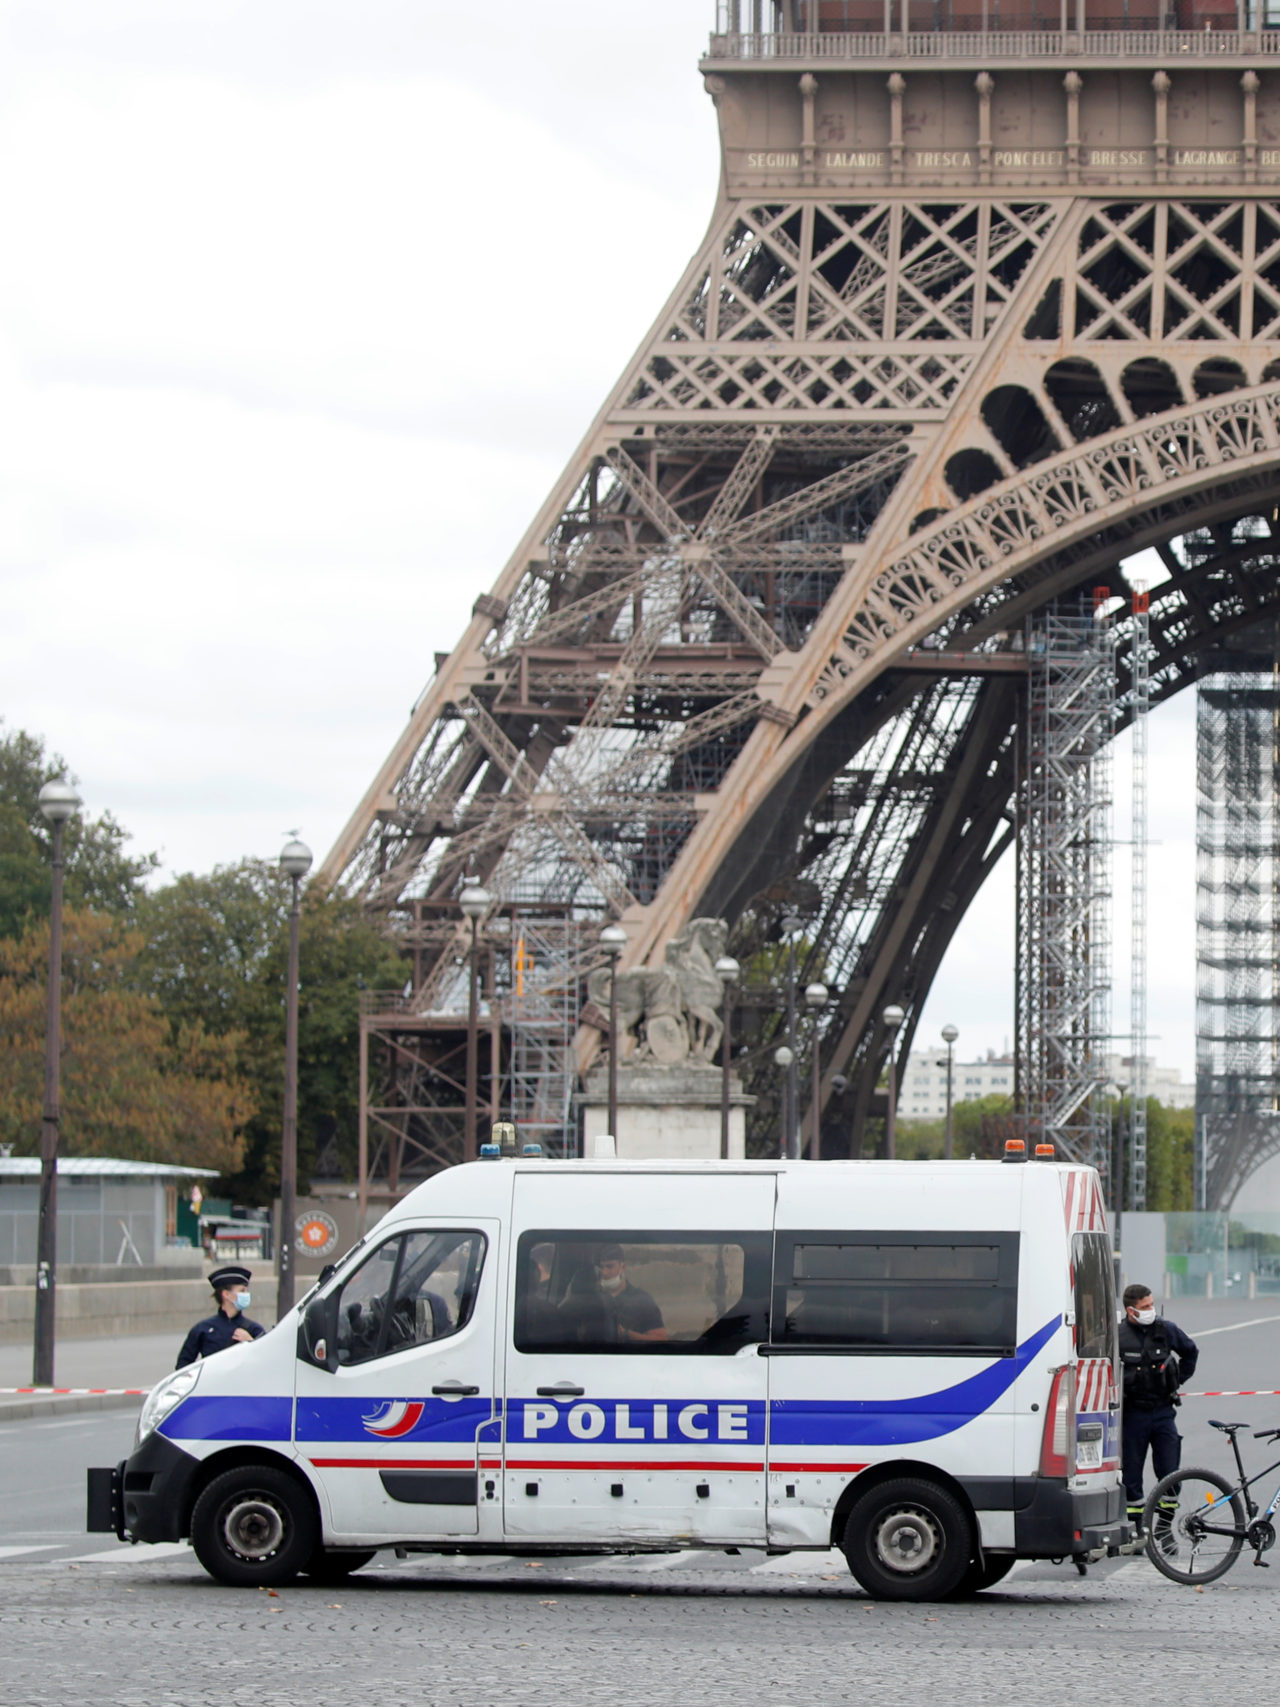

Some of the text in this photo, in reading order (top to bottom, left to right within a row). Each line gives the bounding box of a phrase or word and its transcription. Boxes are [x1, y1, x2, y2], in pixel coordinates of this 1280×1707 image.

[748, 153, 799, 168] SEGUIN
[826, 152, 884, 168] LALANDE
[916, 152, 972, 167] TRESCA
[995, 151, 1064, 166] PONCELET
[1091, 151, 1146, 165] BRESSE
[1175, 150, 1240, 165] LAGRANGE
[523, 1403, 749, 1439] POLICE
